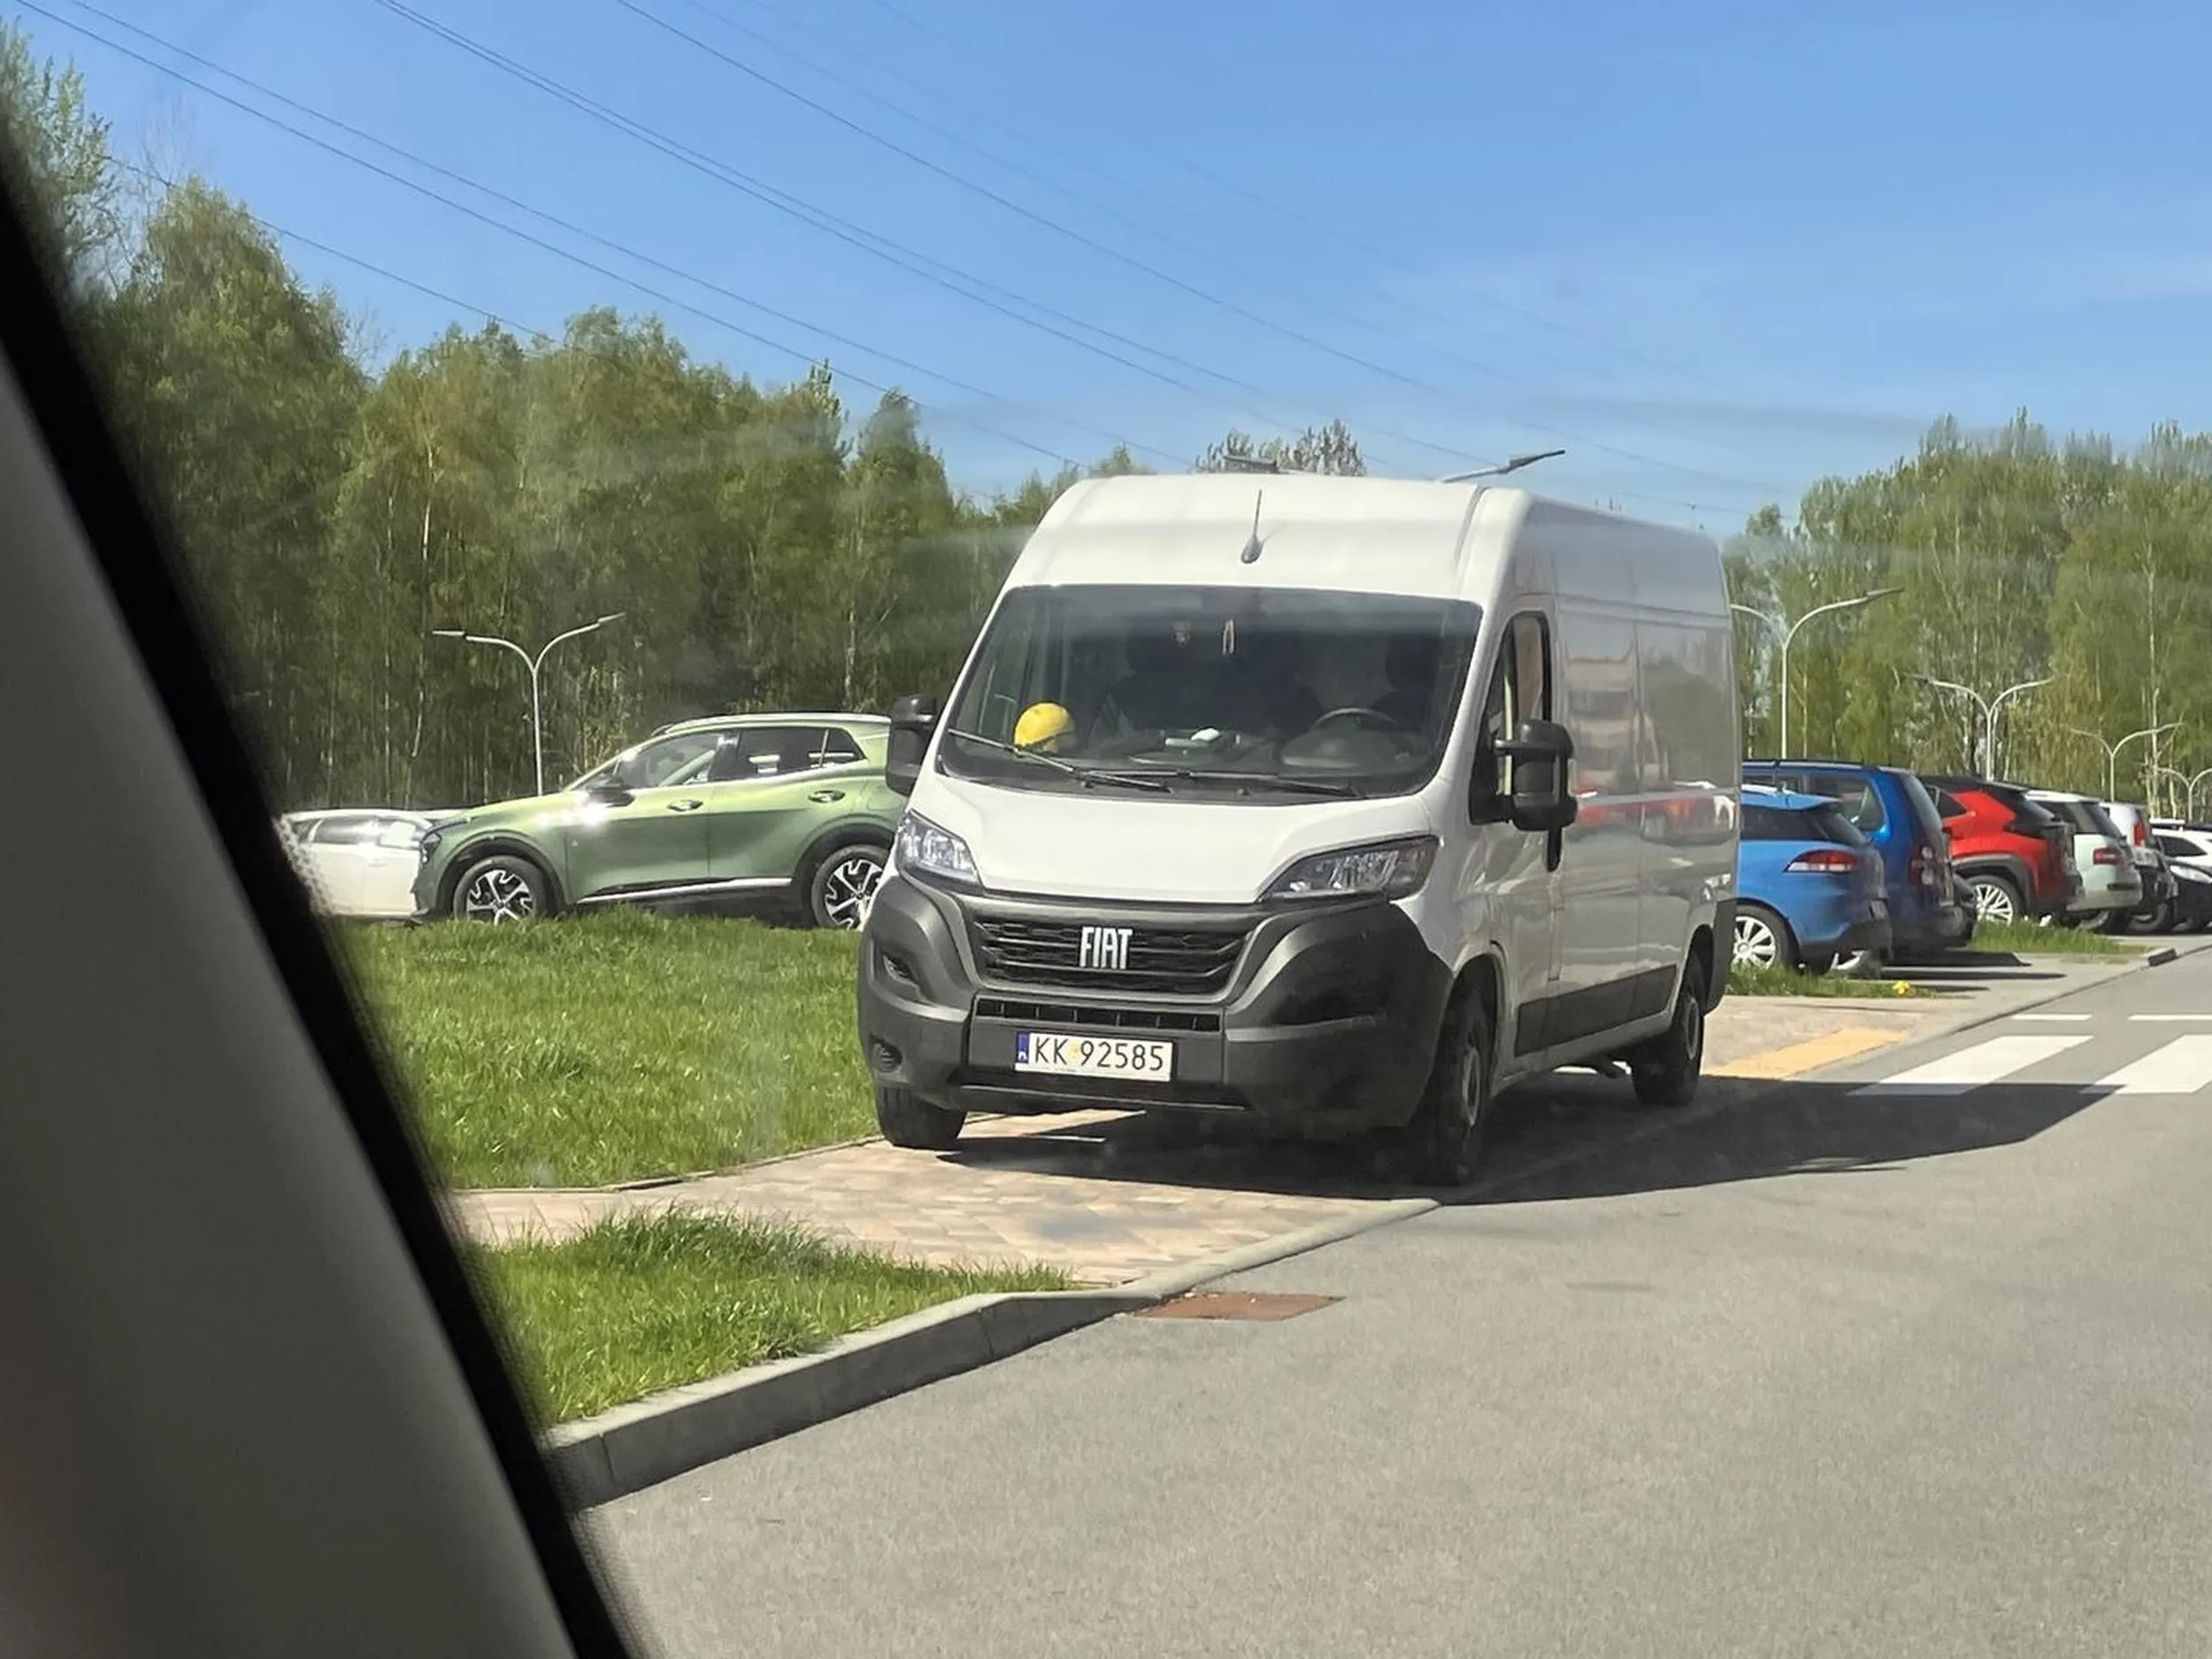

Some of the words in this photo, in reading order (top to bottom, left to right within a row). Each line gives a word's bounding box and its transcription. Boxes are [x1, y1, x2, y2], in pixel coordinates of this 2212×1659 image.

[1079, 926, 1133, 970] FIAT
[1034, 1036, 1069, 1065] KK
[1080, 1040, 1164, 1071] 92585
